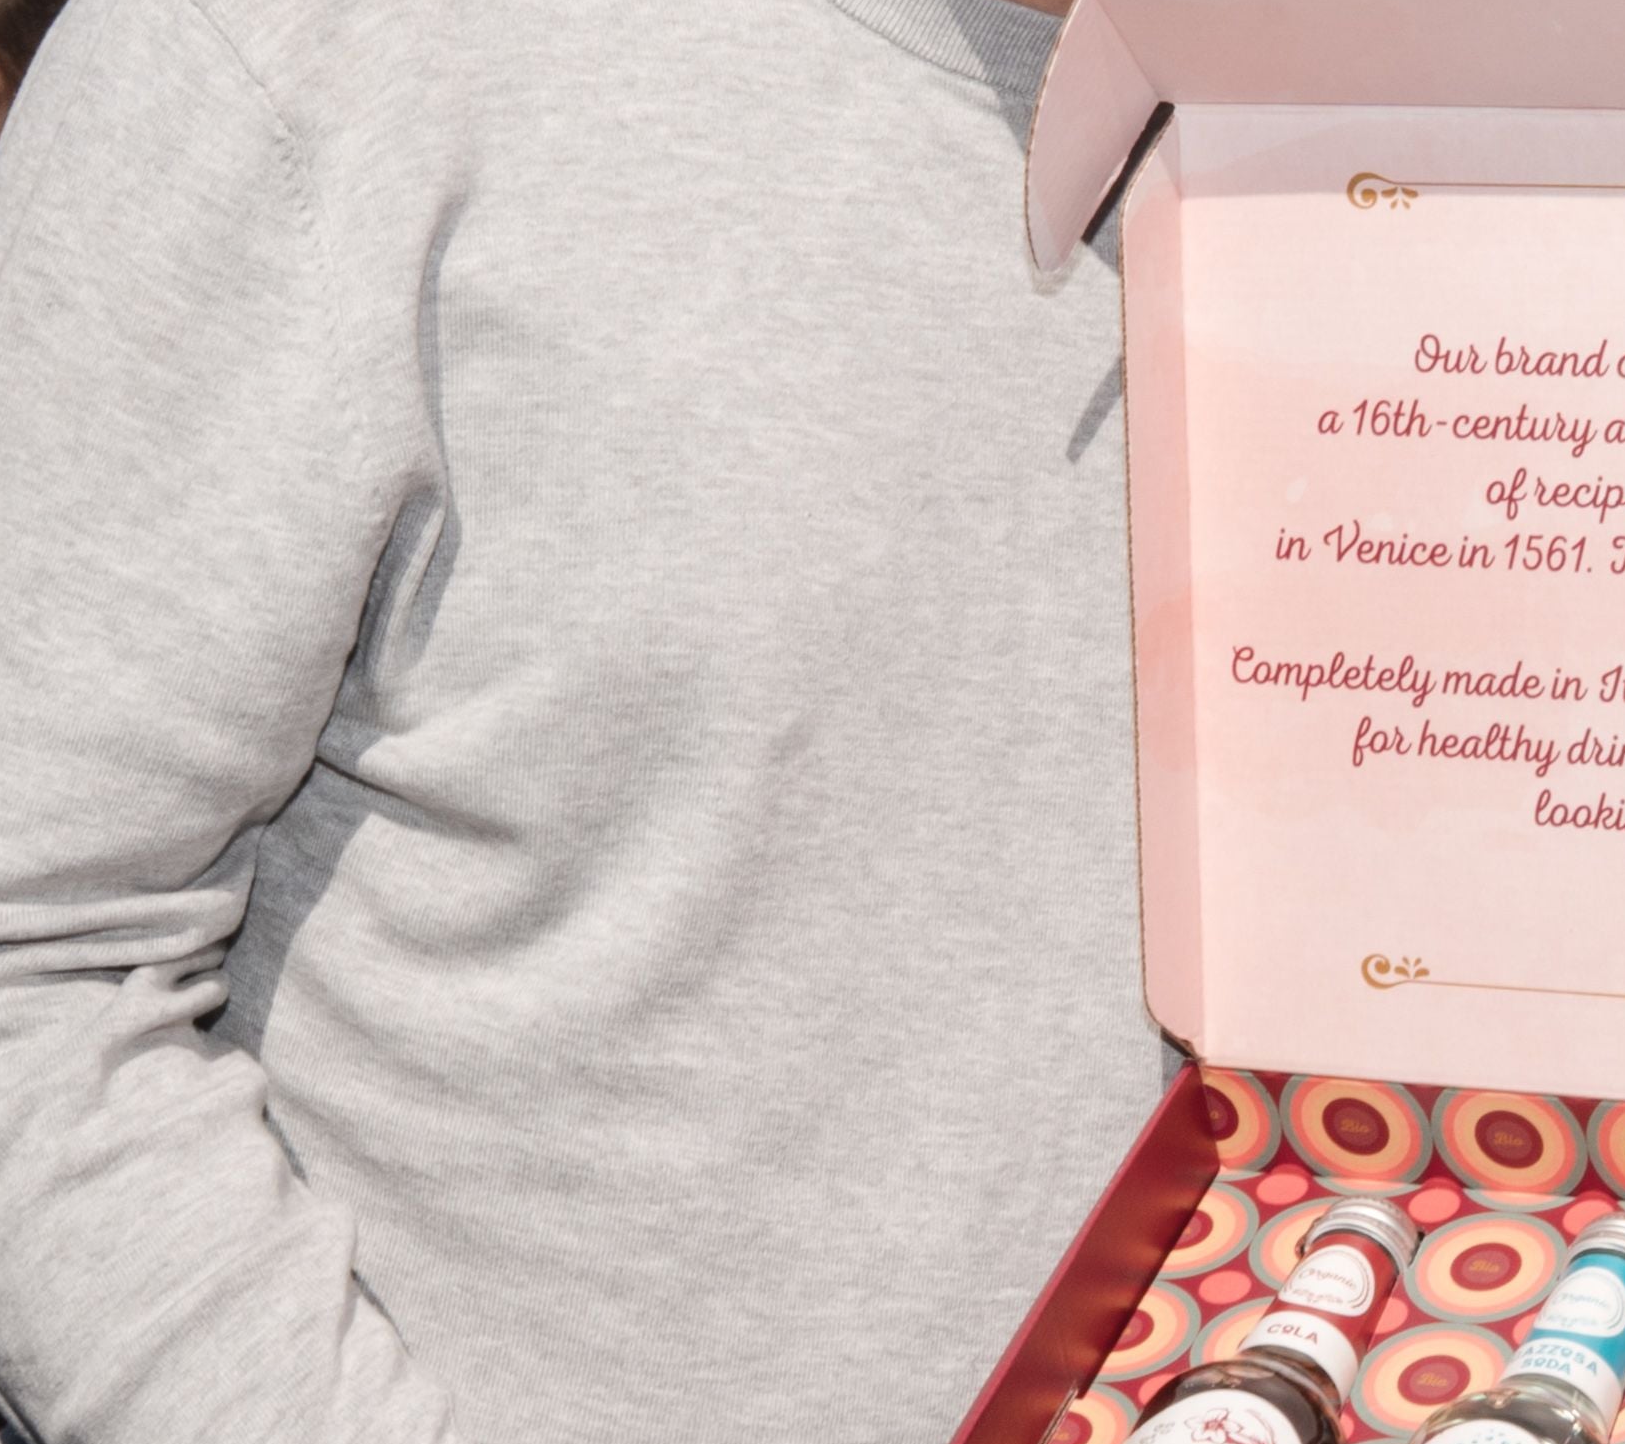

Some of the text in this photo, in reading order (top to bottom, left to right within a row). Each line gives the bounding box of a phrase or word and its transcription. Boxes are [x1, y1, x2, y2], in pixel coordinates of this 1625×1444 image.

[1415, 334, 1487, 374] Our
[1495, 336, 1610, 377] brand
[1317, 410, 1344, 434] a
[1353, 399, 1597, 458] 16th-century
[1486, 467, 1527, 521] of
[1276, 528, 1311, 561] in
[1322, 519, 1453, 570] Venice
[1461, 530, 1496, 570] in
[1504, 531, 1594, 576] 1561.
[1232, 646, 1437, 708] Completely
[1442, 661, 1545, 699] made
[1551, 668, 1588, 701] in
[1352, 716, 1412, 767] for
[1417, 719, 1561, 778] healthy
[1266, 1320, 1320, 1347] COLA
[1519, 1356, 1572, 1377] SODA
